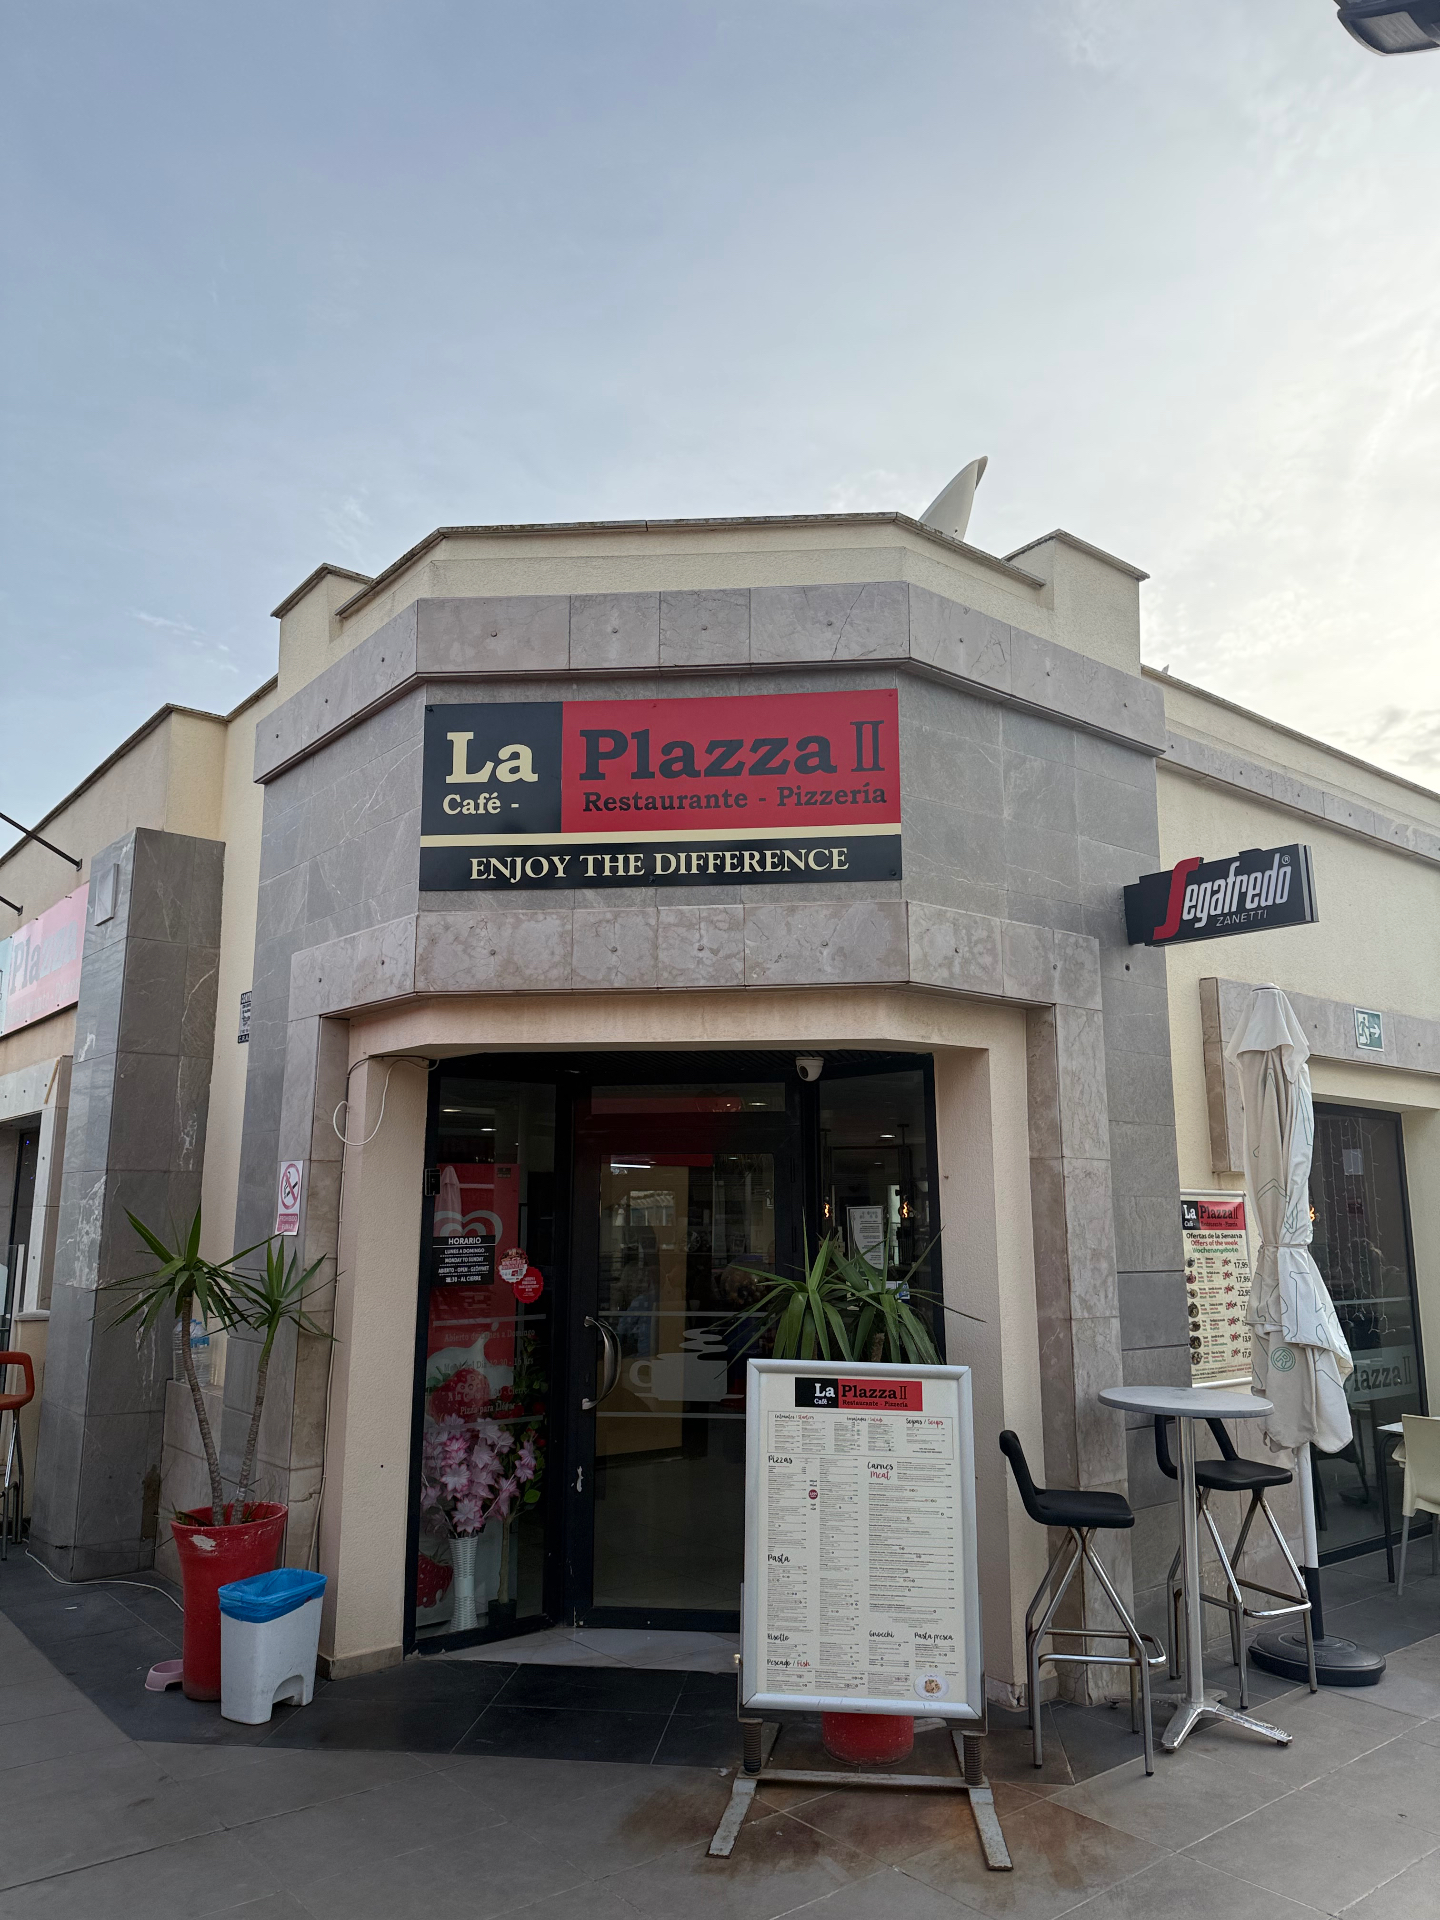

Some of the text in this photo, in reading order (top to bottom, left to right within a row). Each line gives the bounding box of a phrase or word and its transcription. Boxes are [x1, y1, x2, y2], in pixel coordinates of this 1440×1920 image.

[445, 731, 538, 784] La
[578, 728, 838, 781] Plazza
[582, 788, 748, 813] Restaurante
[777, 782, 887, 808] Pizzería
[442, 792, 501, 816] Café
[469, 847, 849, 885] ENJOY THE DIFFERENCE
[1152, 853, 1292, 941] Segafredo
[1216, 909, 1268, 927] ZANETTI
[1183, 1204, 1197, 1219] La
[1199, 1205, 1233, 1219] Plazza
[448, 1237, 482, 1245] HORARIO
[444, 1331, 469, 1342] Abierto
[506, 1329, 535, 1339] Domingo
[814, 1383, 835, 1398] La
[841, 1384, 897, 1399] Plazza
[460, 1405, 478, 1415] Pizza
[479, 1405, 494, 1415] para
[768, 1455, 793, 1464] Pizzas
[867, 1461, 894, 1470] Carnes
[870, 1470, 891, 1480] Meat
[767, 1553, 790, 1564] Pasta
[767, 1633, 790, 1642] Risotto
[869, 1630, 895, 1639] Gnocchi
[914, 1632, 933, 1641] Pasta
[797, 1659, 811, 1667] Fish
